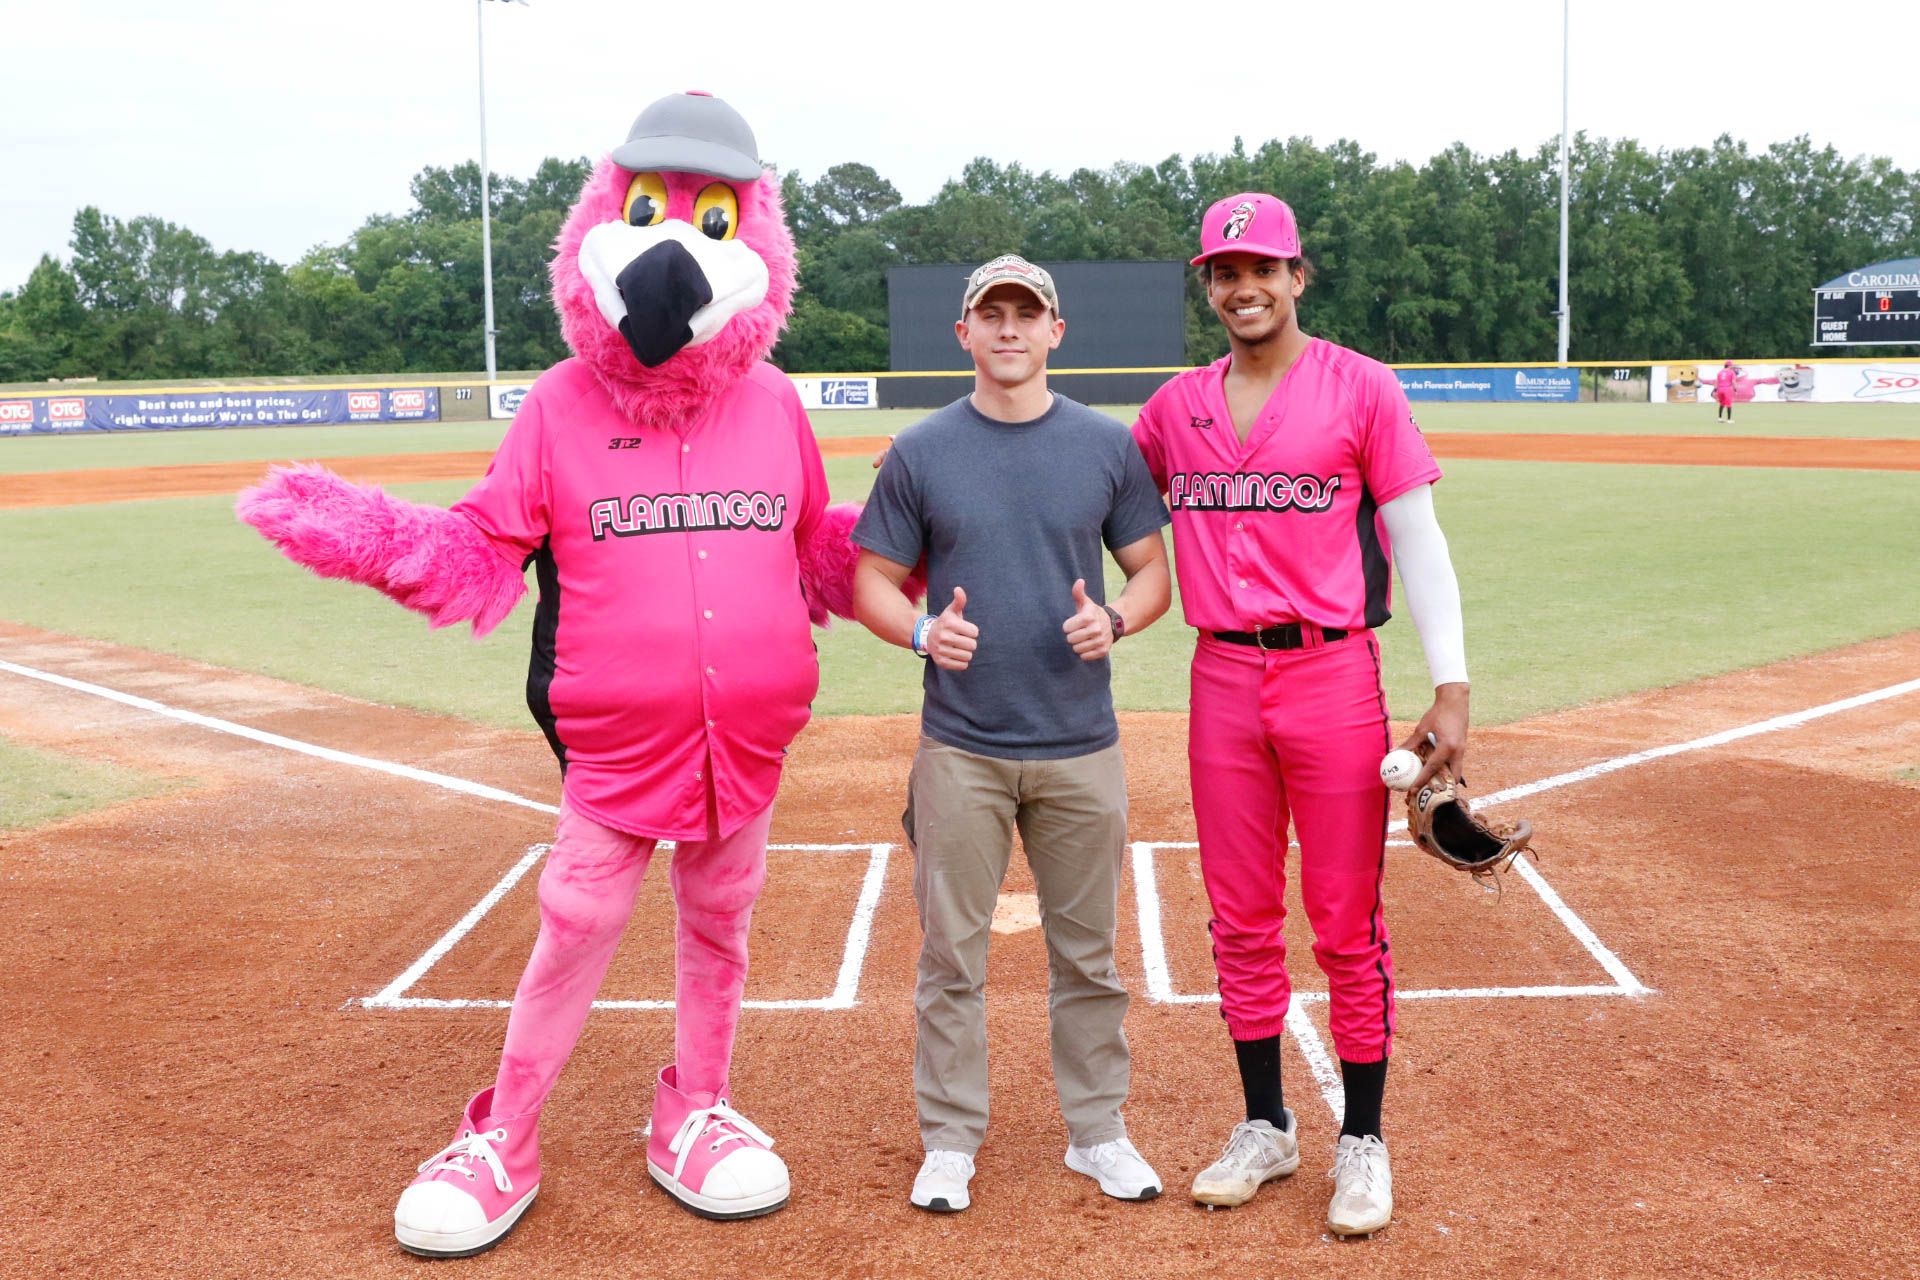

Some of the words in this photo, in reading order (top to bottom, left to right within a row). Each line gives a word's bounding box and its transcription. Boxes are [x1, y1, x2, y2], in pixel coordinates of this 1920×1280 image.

[1848, 272, 1920, 287] CAROLINA
[1880, 298, 1890, 311] 0
[1821, 321, 1848, 331] GUEST
[1823, 332, 1847, 342] HOME
[1614, 369, 1630, 380] 377
[1411, 381, 1423, 389] the
[1424, 381, 1453, 389] Florence
[1454, 381, 1491, 391] Flamingos
[394, 394, 422, 407] OTG
[456, 388, 471, 400] 377
[138, 400, 166, 410] Best
[169, 400, 196, 409] eats
[199, 398, 223, 409] and
[226, 397, 252, 407] best
[256, 396, 295, 408] prices,
[350, 395, 378, 409] OTG
[0, 404, 30, 419] OTG
[51, 402, 83, 417] OTG
[114, 414, 146, 426] right
[150, 414, 178, 424] next
[182, 412, 215, 423] door!
[219, 411, 253, 422] We're
[257, 410, 274, 420] On
[277, 410, 298, 420] The
[1170, 471, 1341, 513] FLAMINGOS
[589, 490, 787, 542] FLAMINGOS
